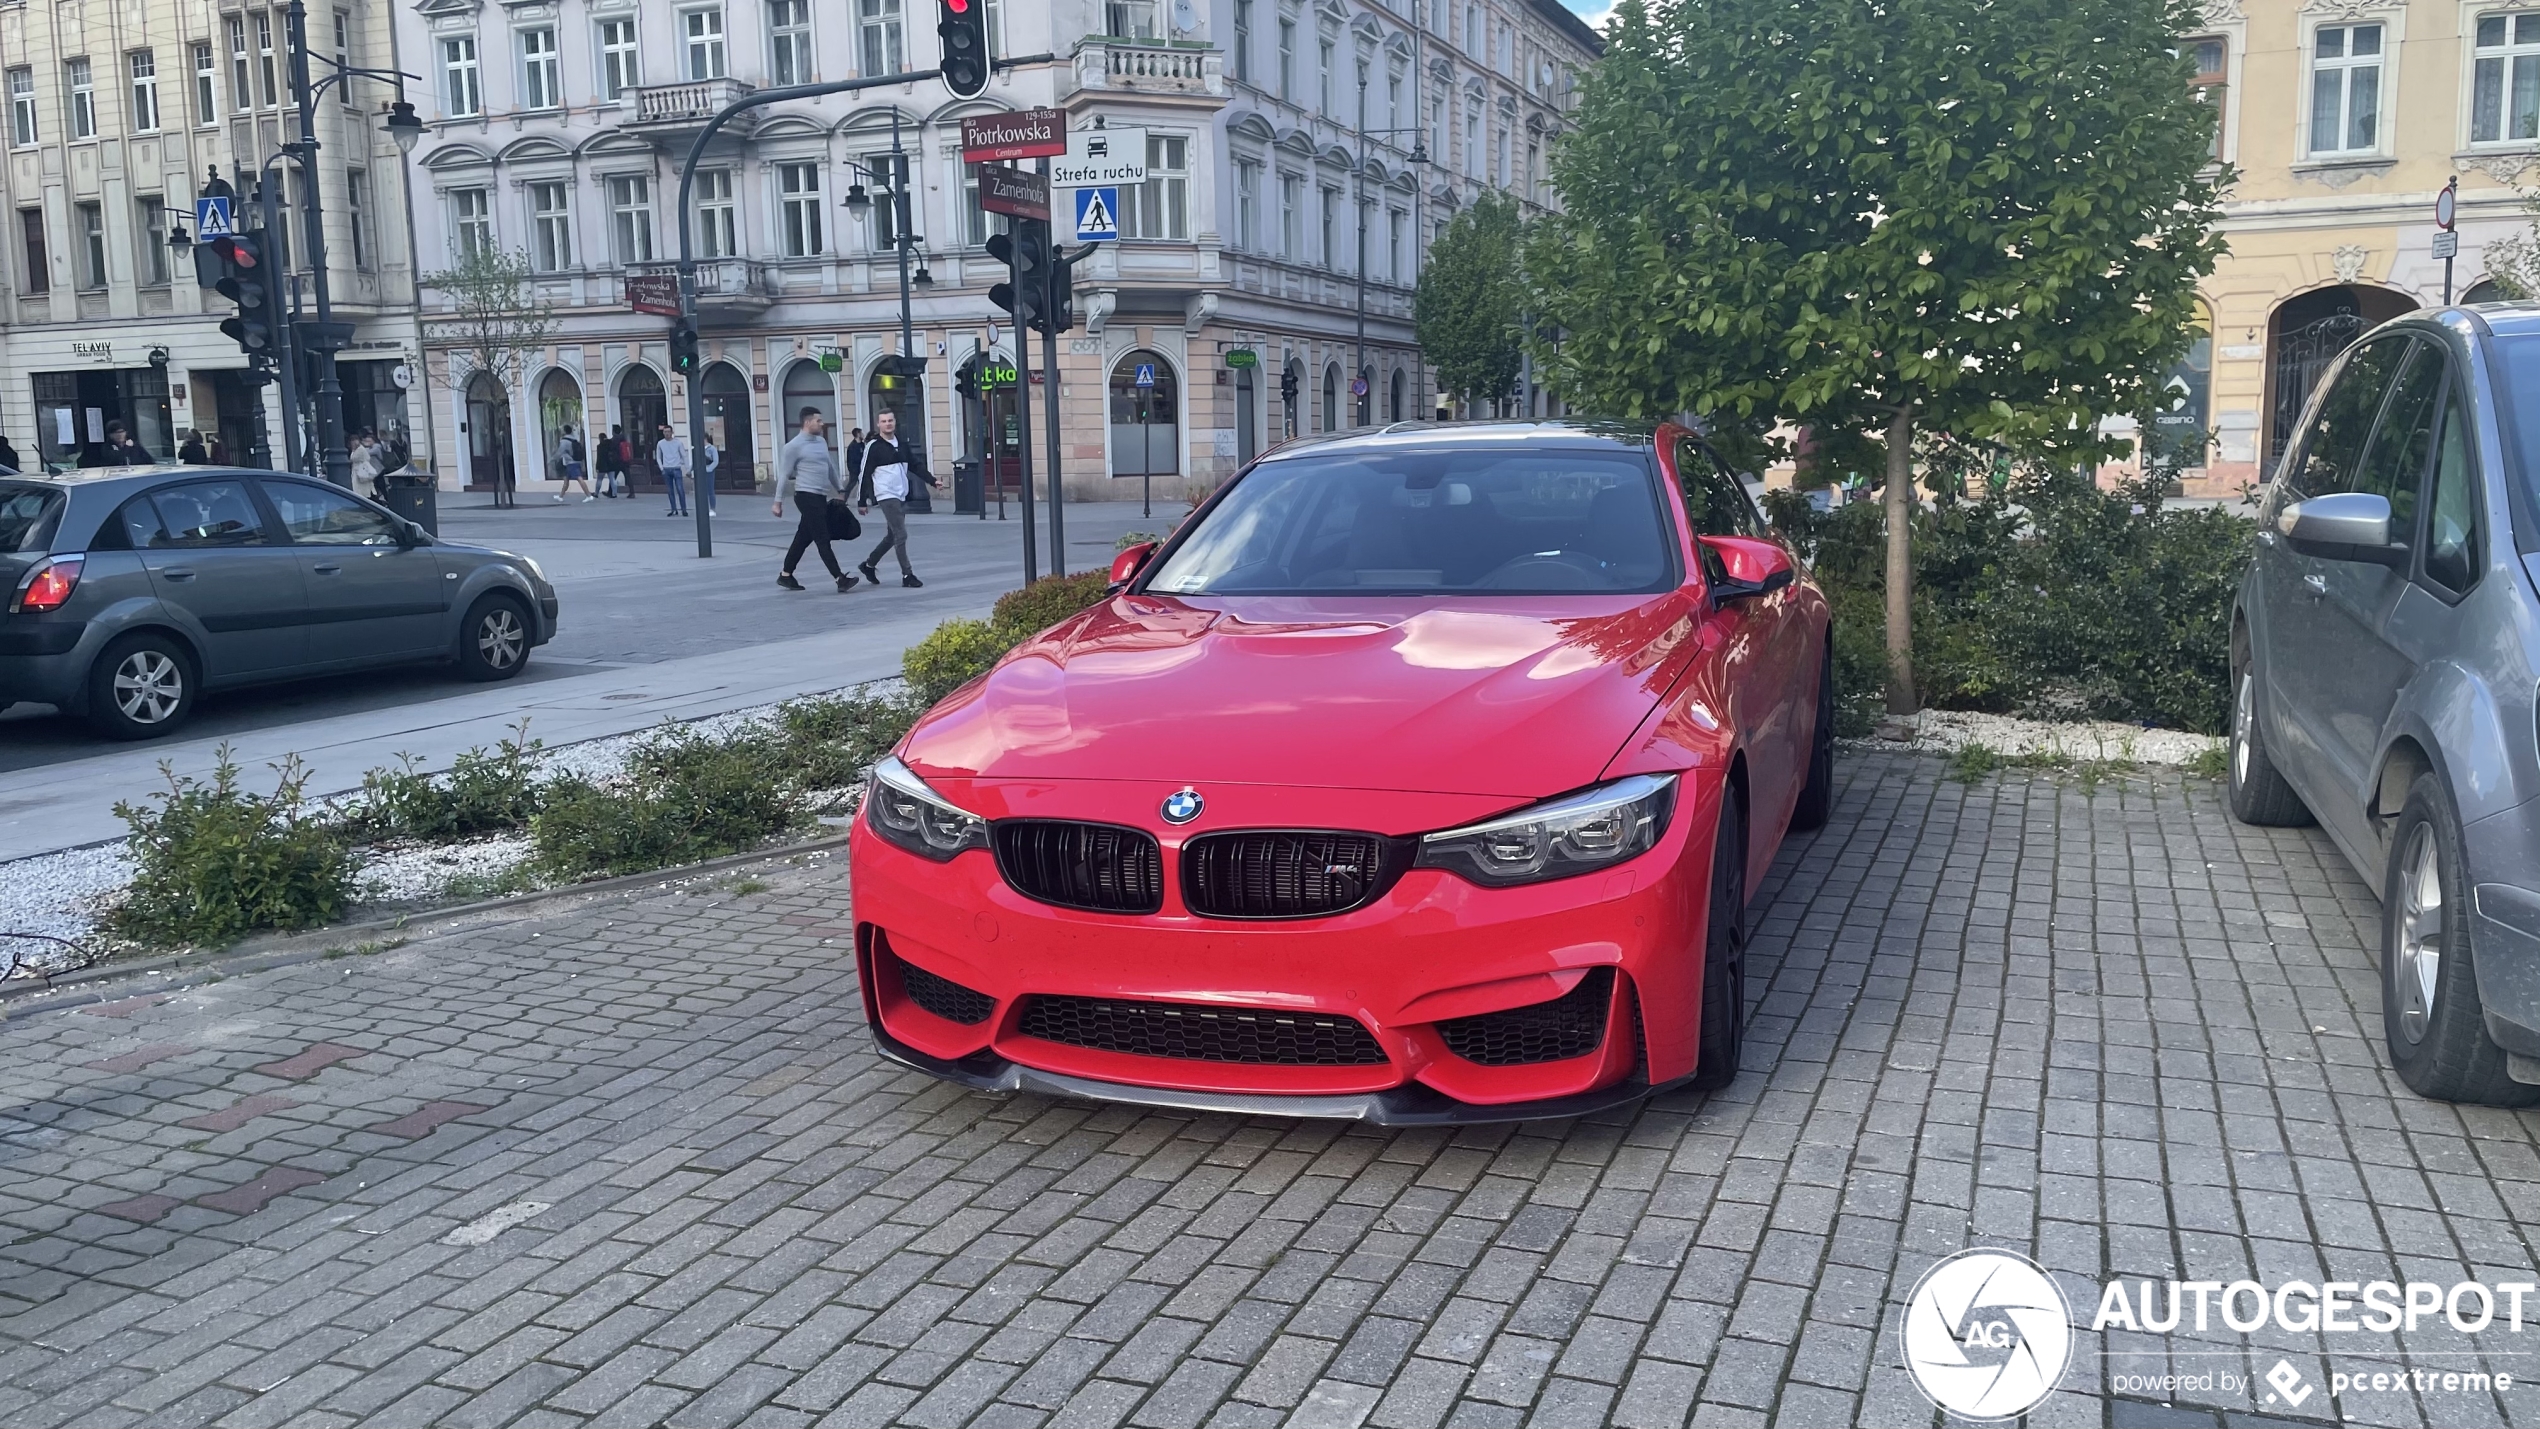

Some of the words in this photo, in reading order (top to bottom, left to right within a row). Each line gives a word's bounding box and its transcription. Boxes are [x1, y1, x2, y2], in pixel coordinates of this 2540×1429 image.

[1025, 110, 1056, 121] 129-155a
[964, 118, 977, 127] ulica
[969, 121, 1051, 147] Piotrkowska
[995, 148, 1023, 158] Centrum
[985, 166, 997, 174] ulica
[1055, 166, 1097, 181] Strefa
[1104, 163, 1143, 179] ruchu
[993, 177, 1044, 204] Zamenhofa
[641, 293, 676, 308] Zamenhofa
[72, 343, 88, 353] TEL
[1228, 354, 1255, 362] żabka
[2156, 416, 2195, 424] casino
